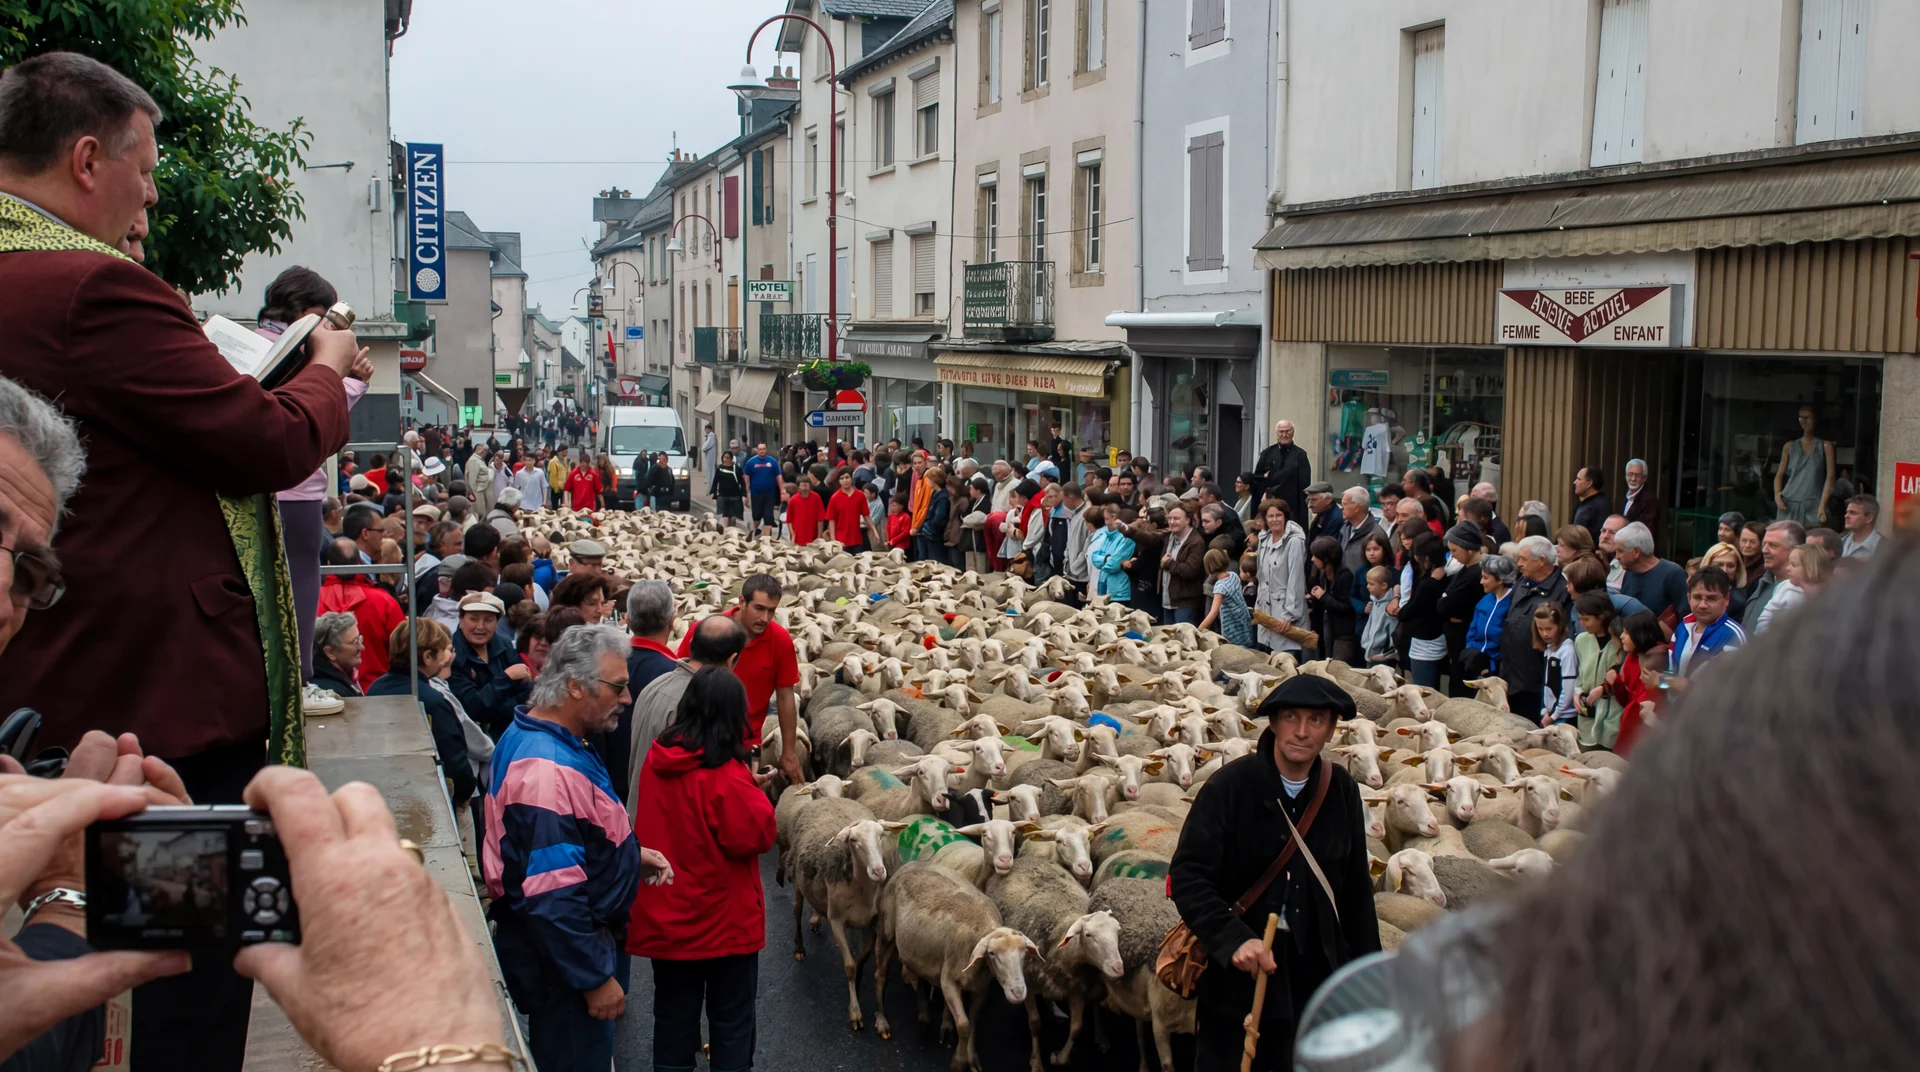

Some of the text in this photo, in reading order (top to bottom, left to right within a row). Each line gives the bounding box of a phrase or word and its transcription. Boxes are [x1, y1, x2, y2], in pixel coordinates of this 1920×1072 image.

[413, 150, 440, 264] CITIZEN
[750, 282, 788, 292] HOTEL
[1502, 325, 1540, 339] FEMME
[1614, 326, 1664, 342] ENFANT
